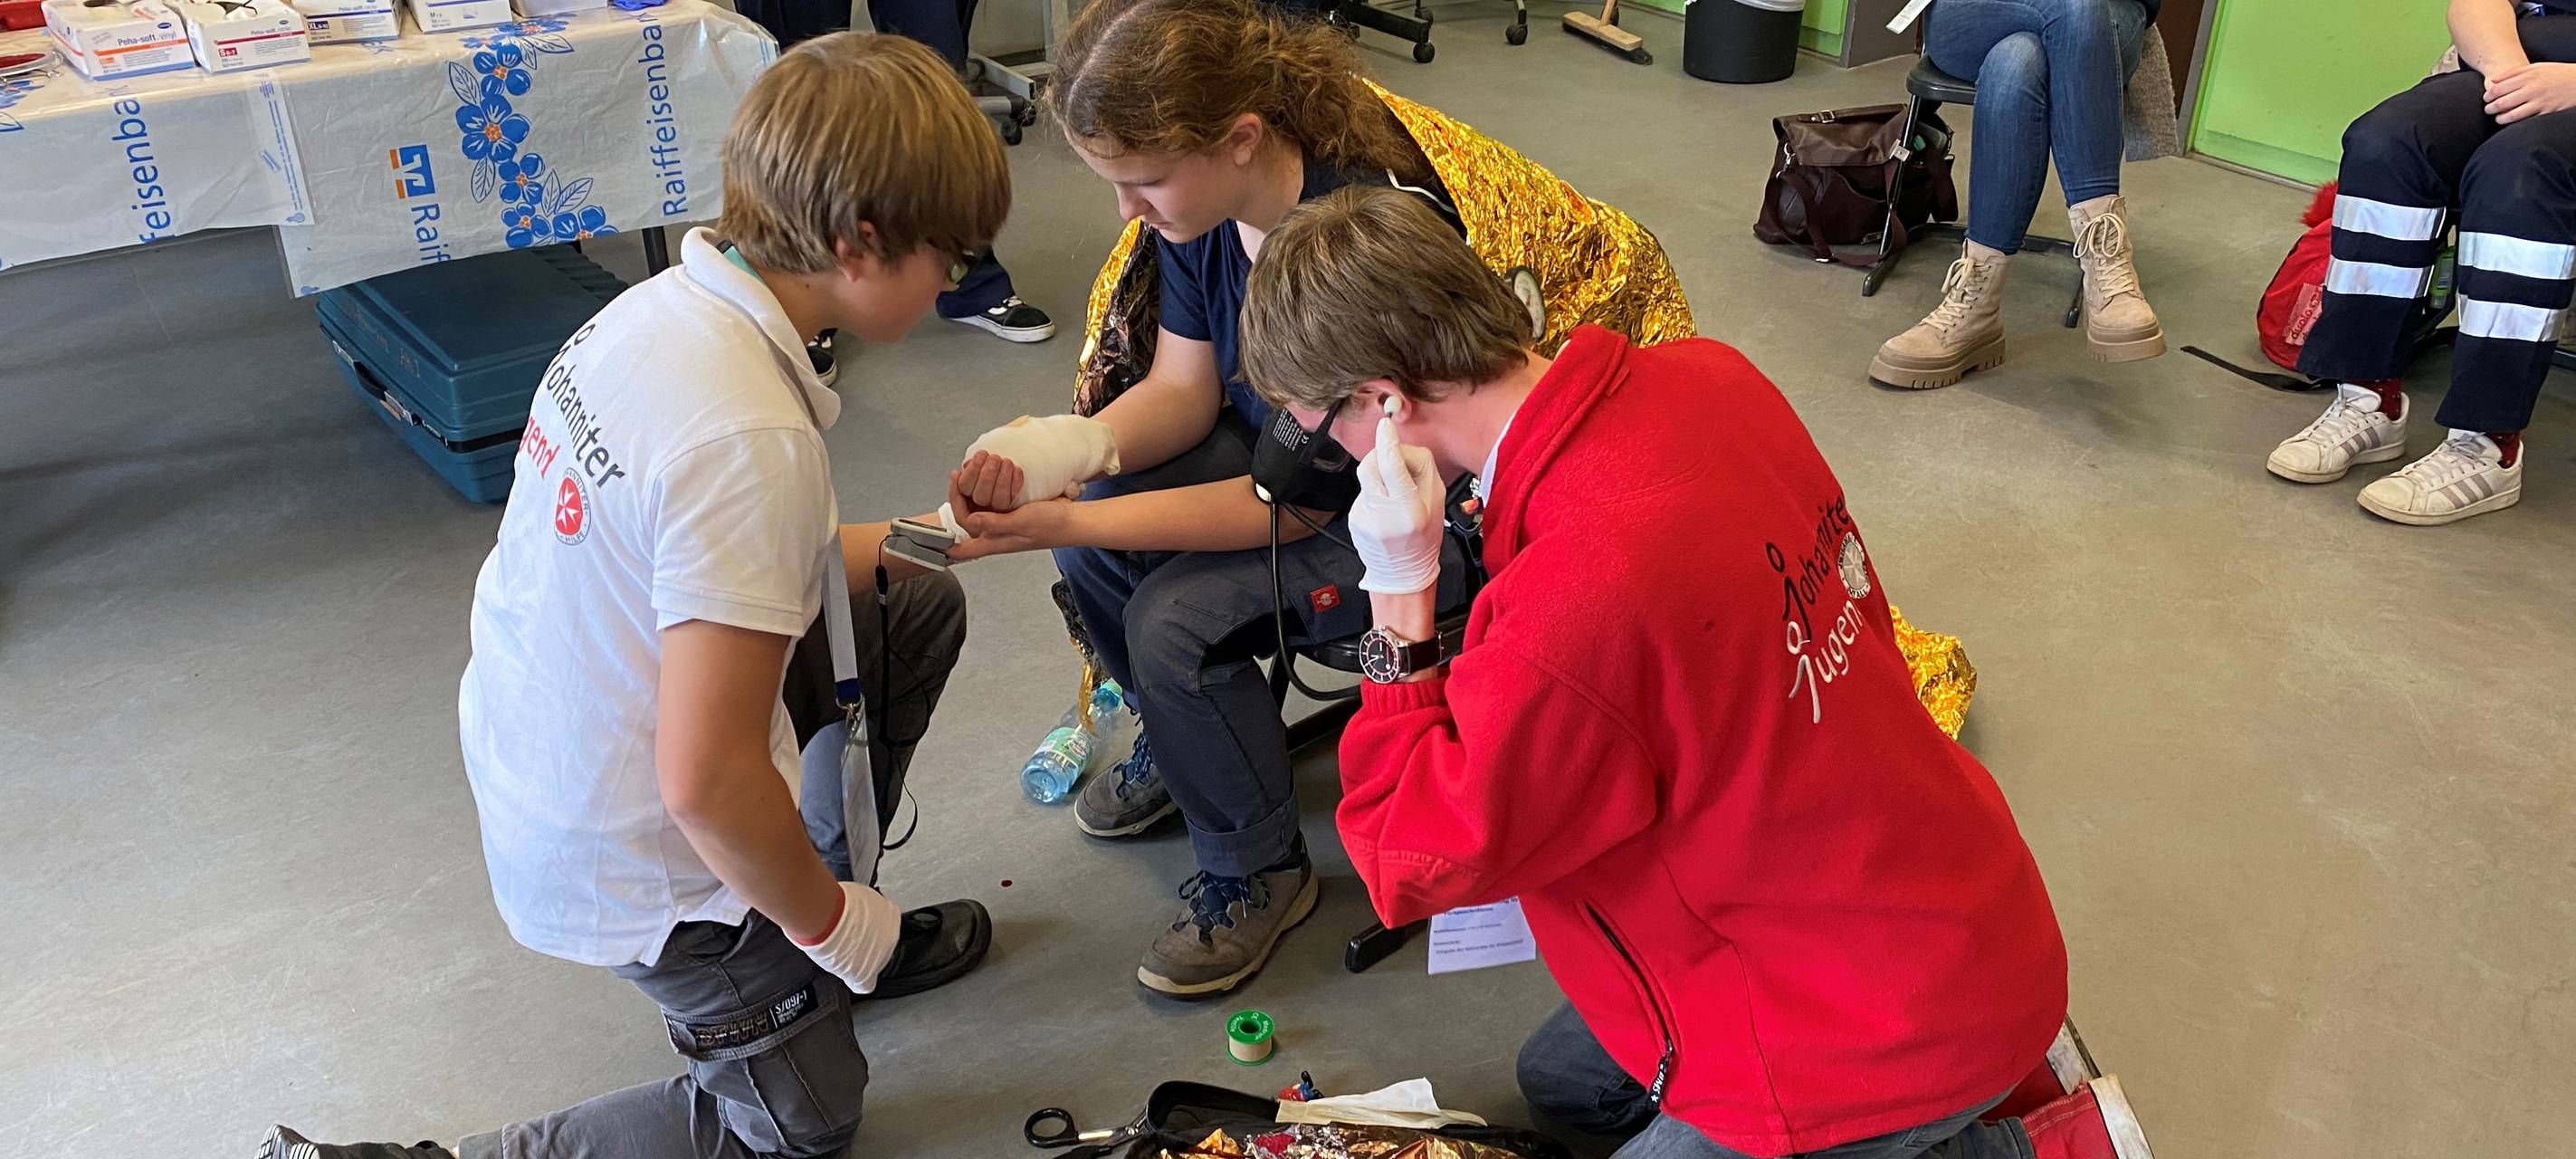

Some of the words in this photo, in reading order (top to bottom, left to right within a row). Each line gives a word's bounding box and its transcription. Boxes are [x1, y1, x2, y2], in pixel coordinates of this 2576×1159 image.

[637, 12, 688, 216] Raiffeisenba
[411, 203, 451, 261] Raif
[544, 344, 625, 488] Johanniter
[1789, 600, 1863, 723] Jugen
